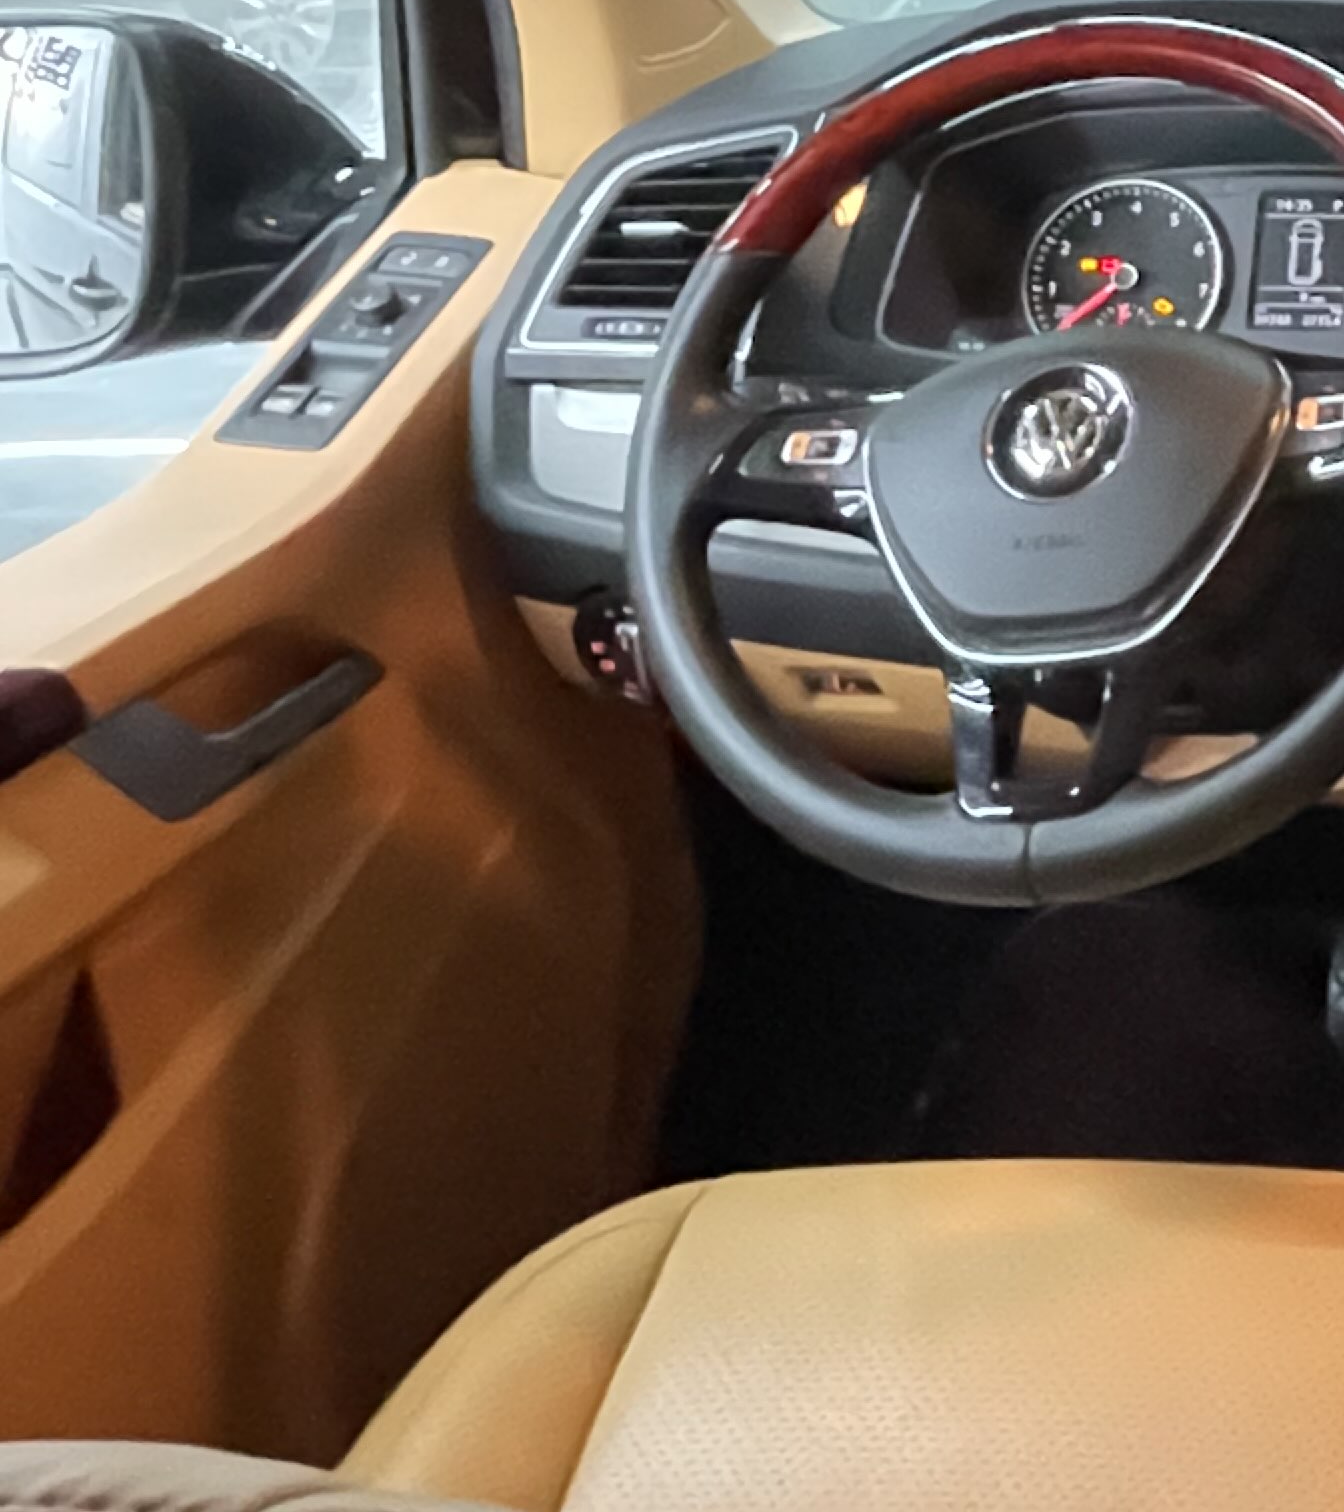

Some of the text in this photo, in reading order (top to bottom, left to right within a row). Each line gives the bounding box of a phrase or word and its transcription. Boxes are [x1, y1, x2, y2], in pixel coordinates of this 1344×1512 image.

[1130, 200, 1142, 215] 4
[1333, 199, 1344, 212] P
[1092, 212, 1103, 227] 3
[1169, 212, 1180, 227] 5
[1060, 240, 1071, 256] 2
[1193, 241, 1205, 257] 6
[1048, 281, 1057, 298] 1
[1199, 283, 1209, 298] 7
